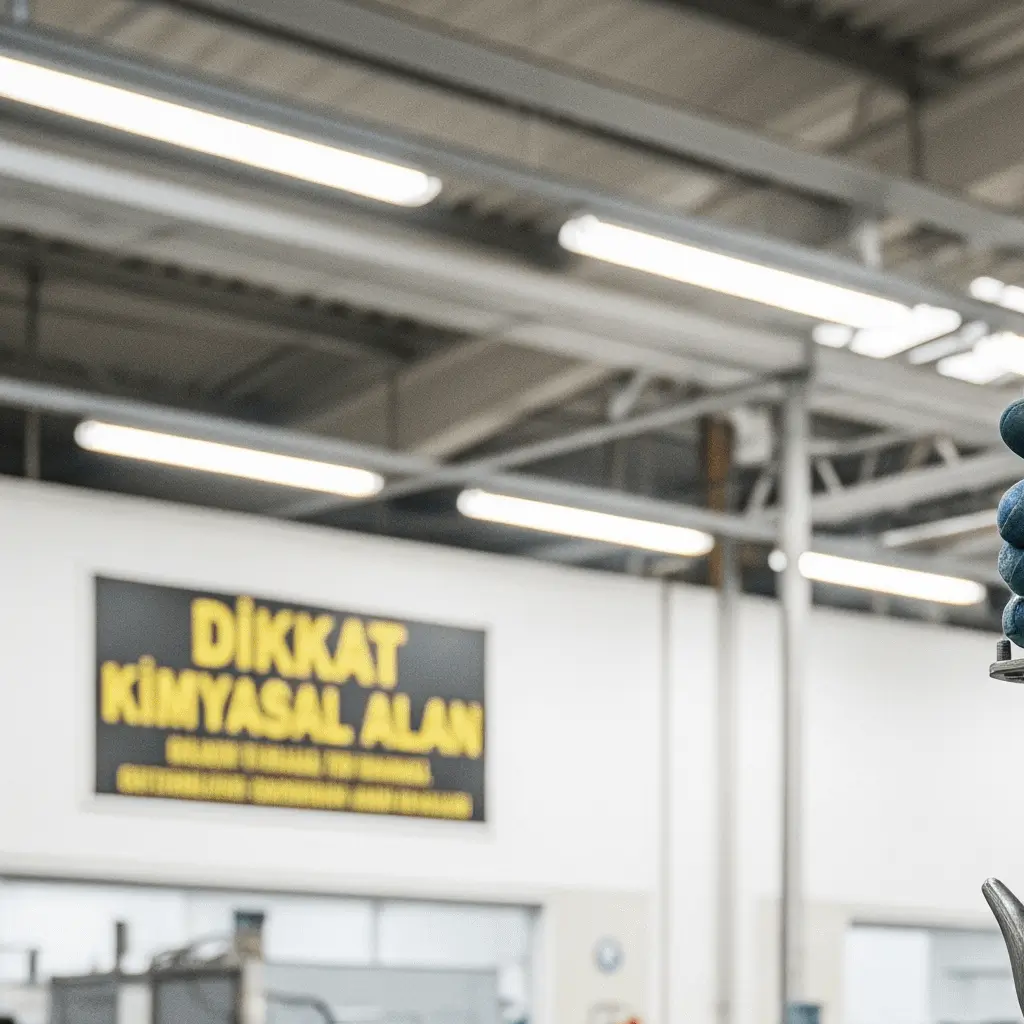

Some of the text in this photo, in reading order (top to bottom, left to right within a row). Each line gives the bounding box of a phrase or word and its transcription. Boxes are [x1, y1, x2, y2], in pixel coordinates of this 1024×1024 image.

[191, 596, 408, 688] DİKKAT
[101, 656, 484, 758] KİMYASAL ALAN
